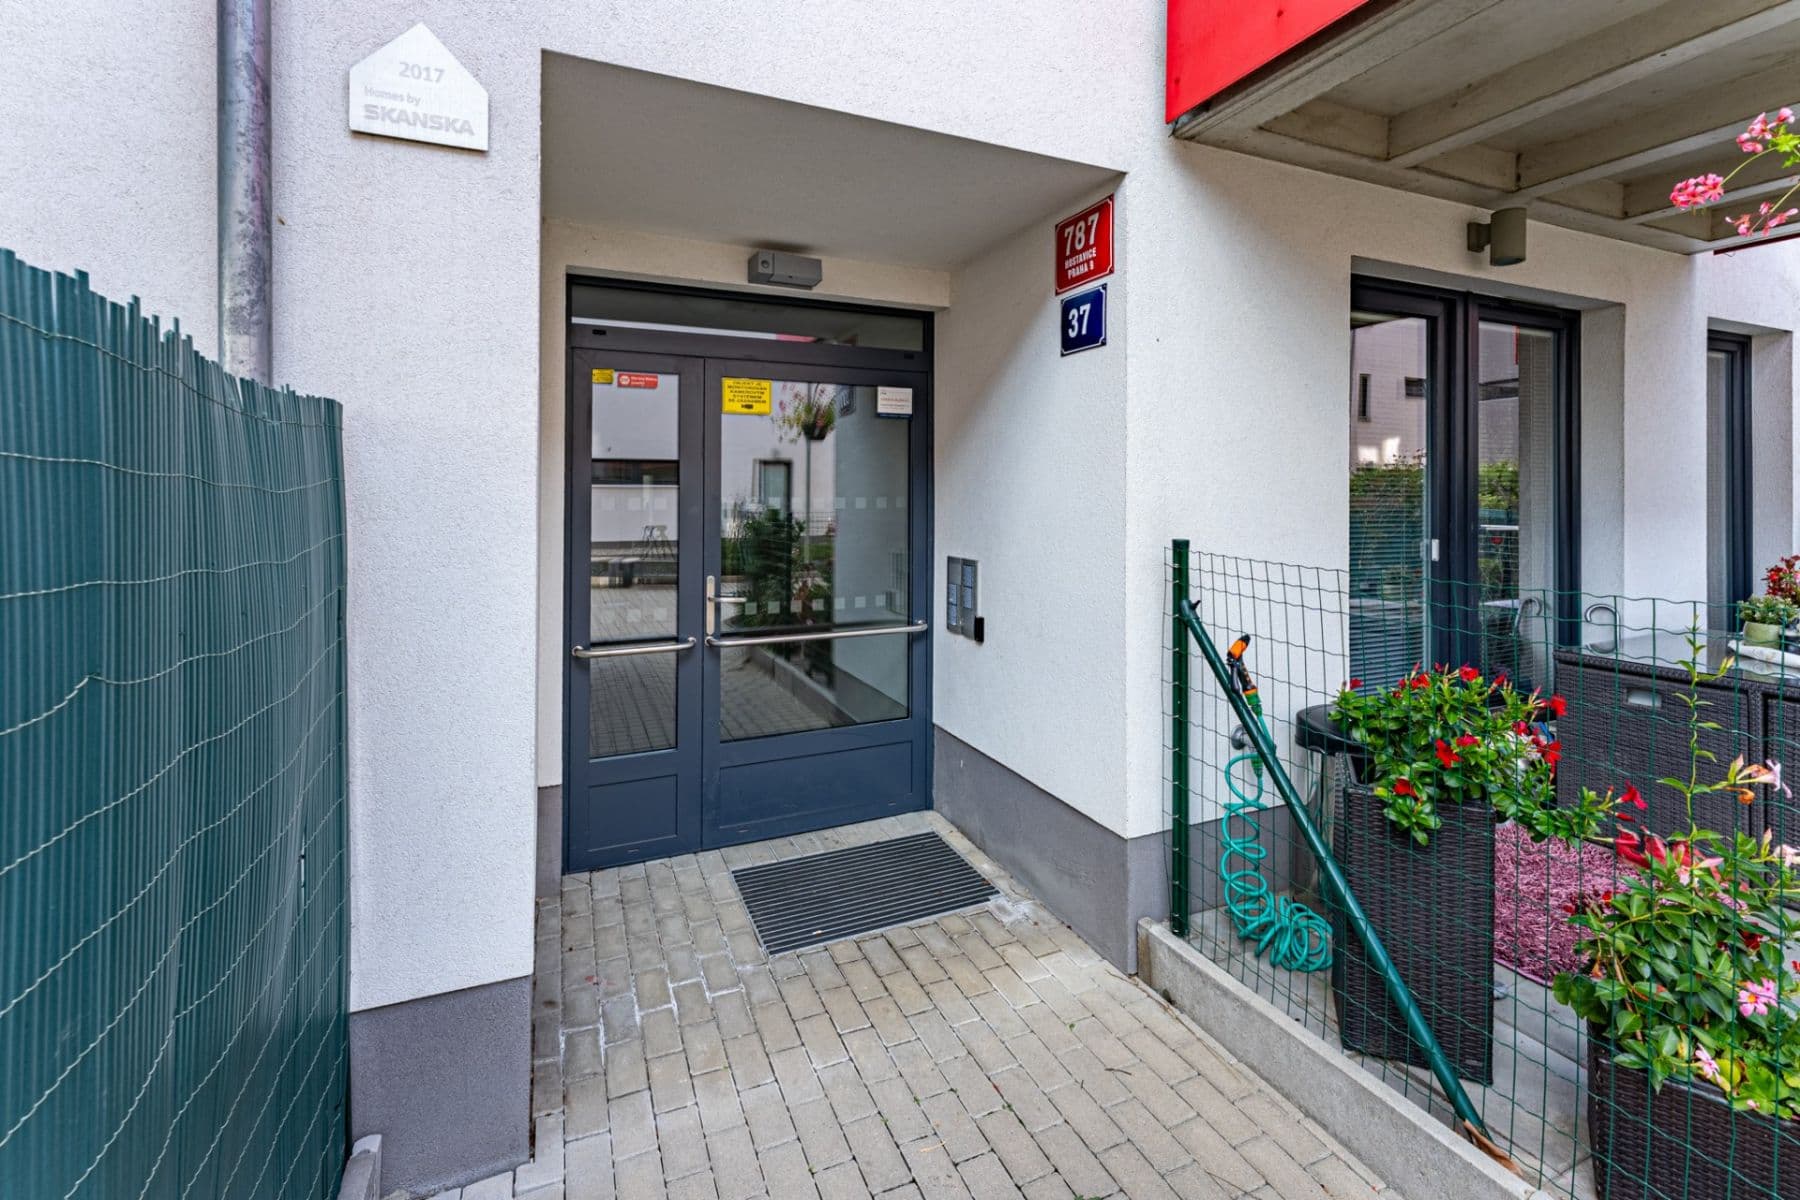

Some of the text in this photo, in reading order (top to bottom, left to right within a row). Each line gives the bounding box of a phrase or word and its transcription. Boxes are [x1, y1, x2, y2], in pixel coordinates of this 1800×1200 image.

[399, 61, 445, 83] 2017
[406, 93, 421, 106] by
[363, 104, 475, 136] SKANSKA
[1064, 212, 1099, 256] 787
[1067, 262, 1088, 279] PRAHA
[1068, 303, 1091, 338] 37
